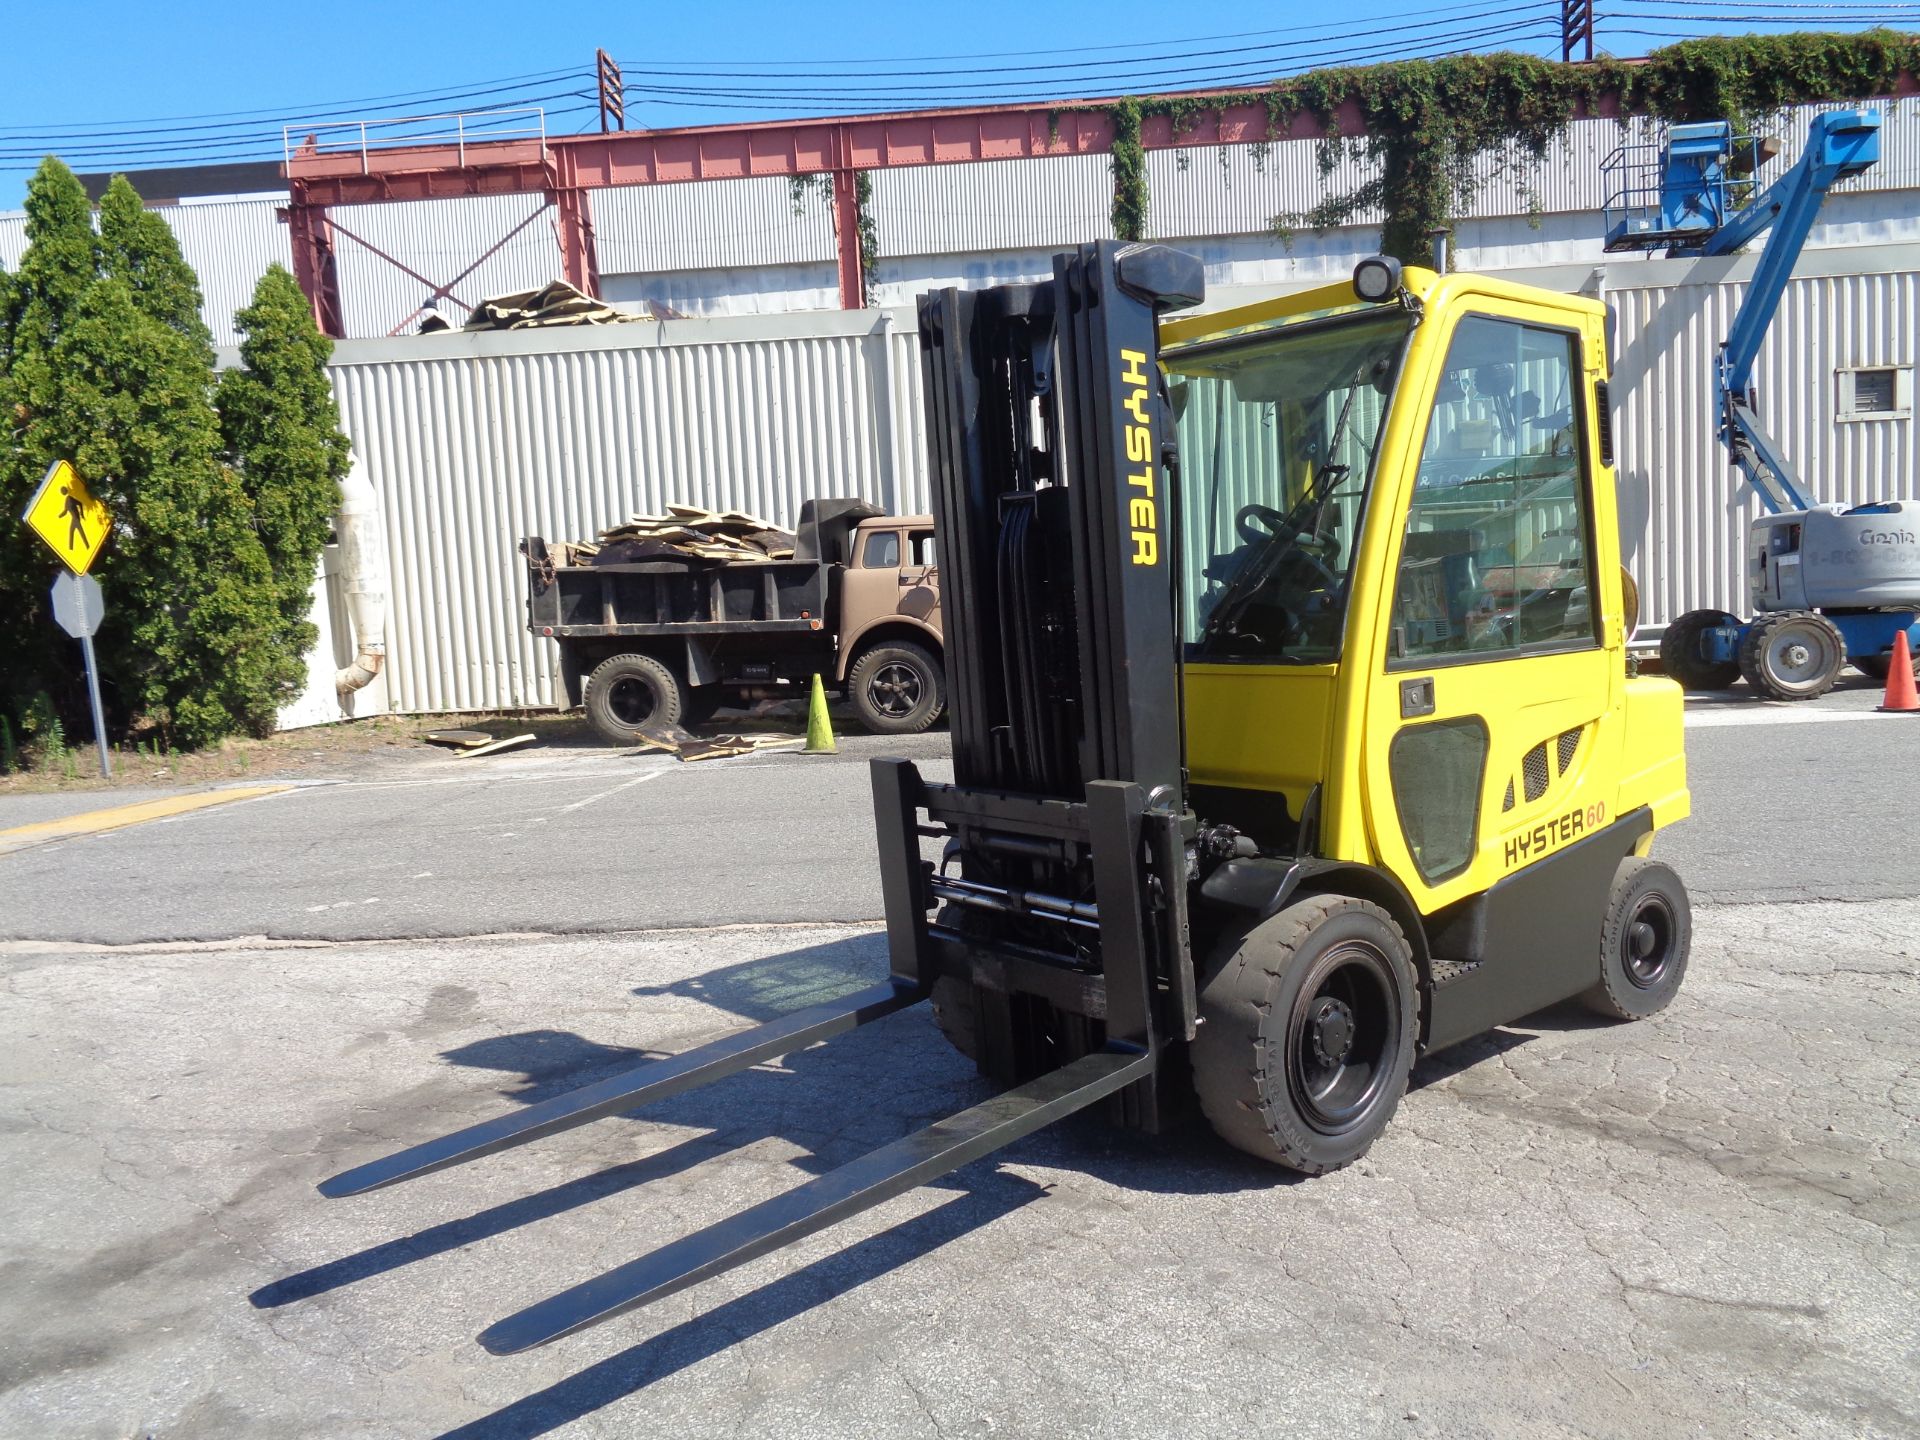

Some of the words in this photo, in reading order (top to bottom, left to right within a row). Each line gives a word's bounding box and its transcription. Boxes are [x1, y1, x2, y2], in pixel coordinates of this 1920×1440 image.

[1121, 348, 1157, 566] HYSTER
[1504, 808, 1584, 868] HYSTER
[1586, 800, 1605, 828] 60
